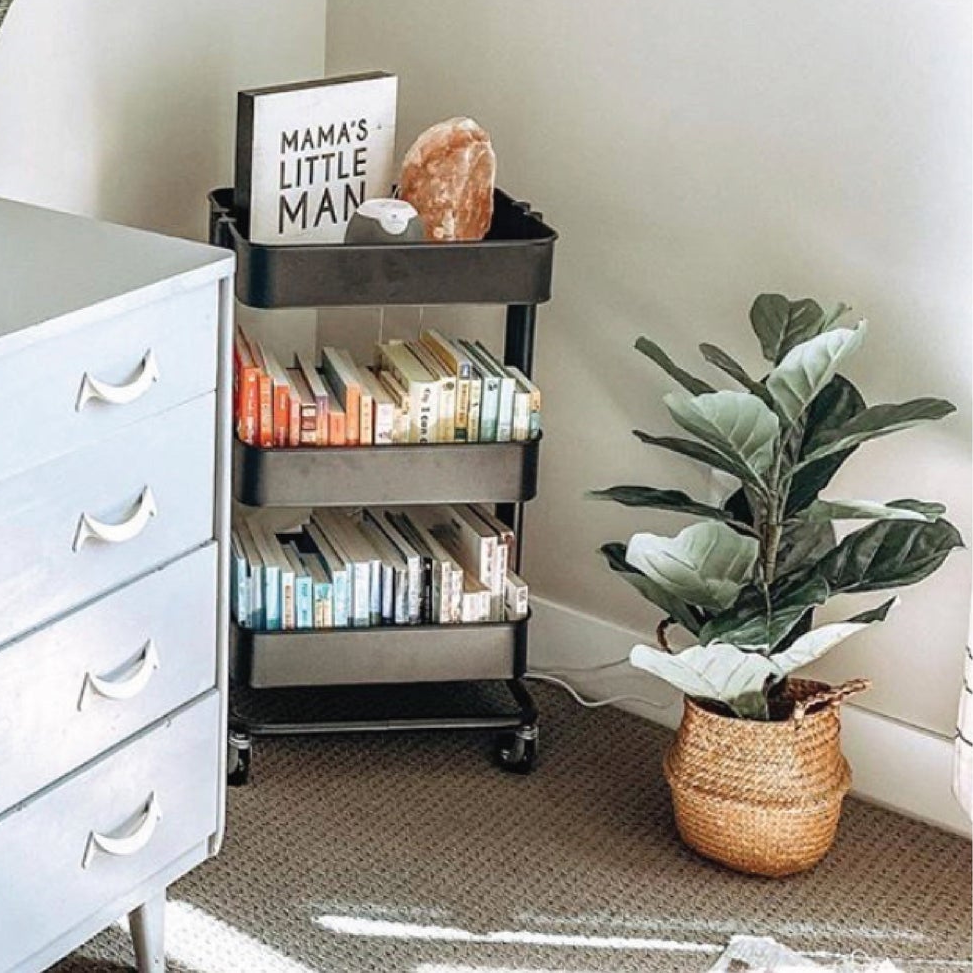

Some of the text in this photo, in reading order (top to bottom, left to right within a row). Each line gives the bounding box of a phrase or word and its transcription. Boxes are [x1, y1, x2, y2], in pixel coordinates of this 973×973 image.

[280, 118, 368, 155] MAMA'S
[279, 147, 367, 190] LITTLE
[278, 181, 366, 235] MAN
